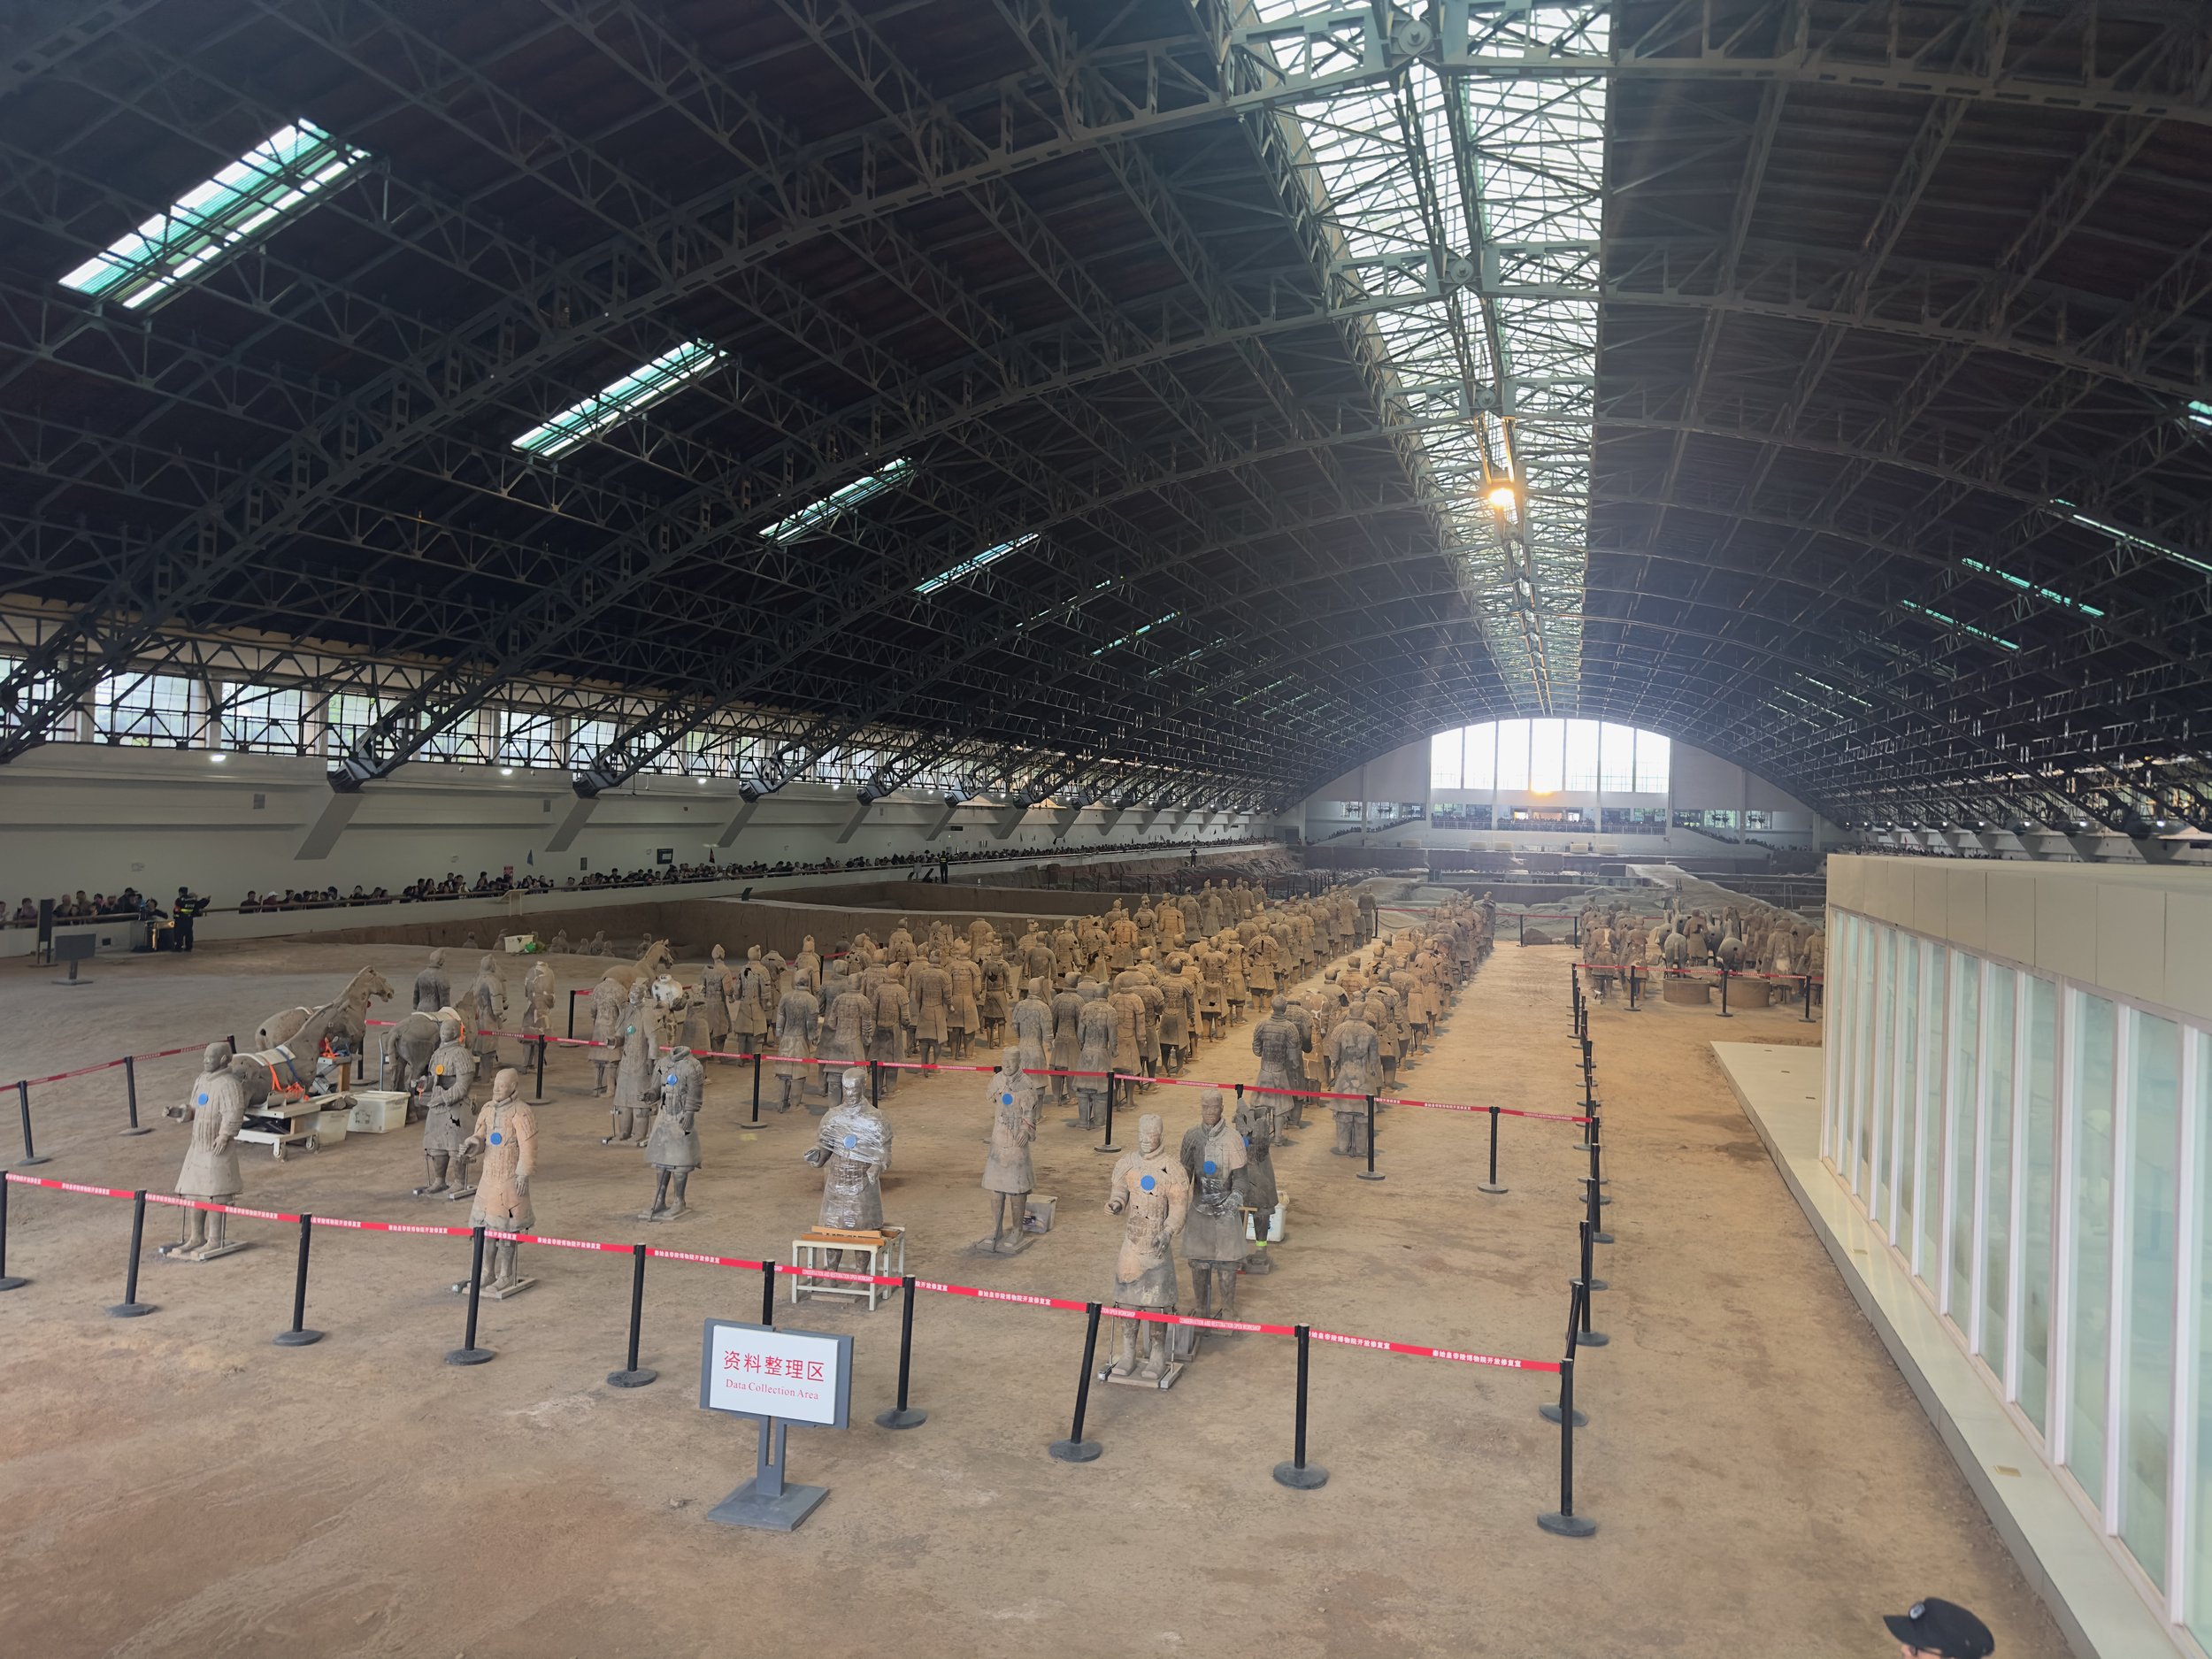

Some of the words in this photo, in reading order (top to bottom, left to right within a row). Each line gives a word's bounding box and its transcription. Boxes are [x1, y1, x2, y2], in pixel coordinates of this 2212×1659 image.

[724, 1350, 825, 1382] 资料整理区
[726, 1379, 747, 1390] Data
[749, 1382, 795, 1397] Collection
[797, 1389, 818, 1400] Area
